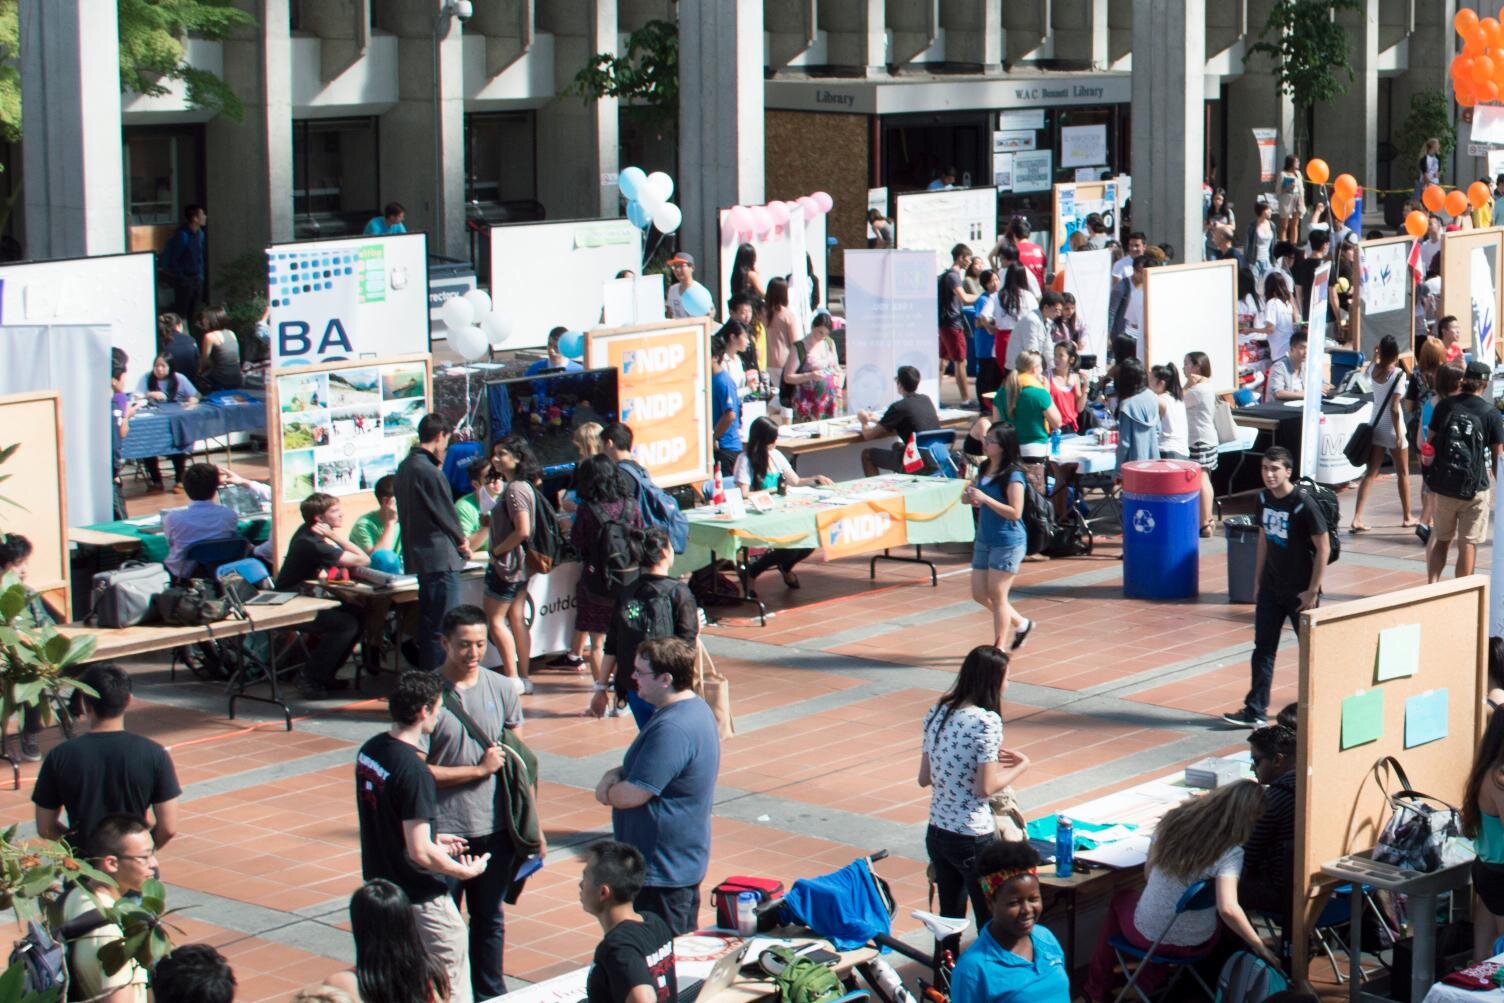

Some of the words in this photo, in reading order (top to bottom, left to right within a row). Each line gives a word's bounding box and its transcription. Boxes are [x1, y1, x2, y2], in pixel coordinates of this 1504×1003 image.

[816, 90, 855, 106] Library
[1073, 85, 1104, 98] Library
[637, 343, 686, 374] NDP
[634, 391, 684, 422] NDP
[637, 436, 687, 467] NDP
